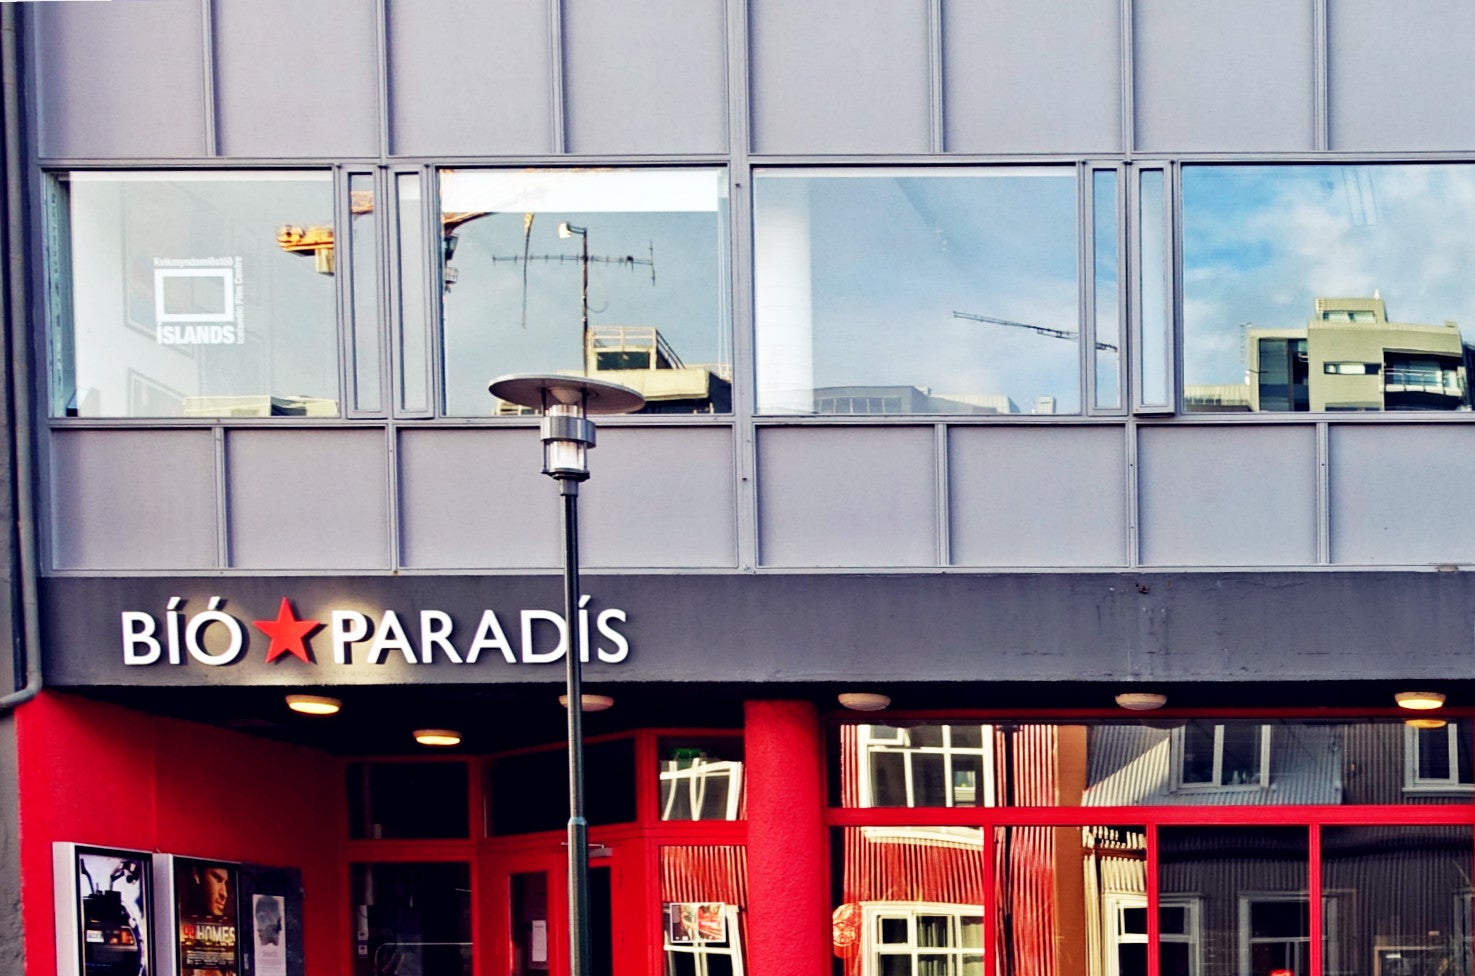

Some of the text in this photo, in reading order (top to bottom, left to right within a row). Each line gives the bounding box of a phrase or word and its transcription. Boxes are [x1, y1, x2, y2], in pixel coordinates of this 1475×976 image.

[122, 594, 630, 666] BÍÓ PARADÍS
[197, 925, 236, 943] HOMES
